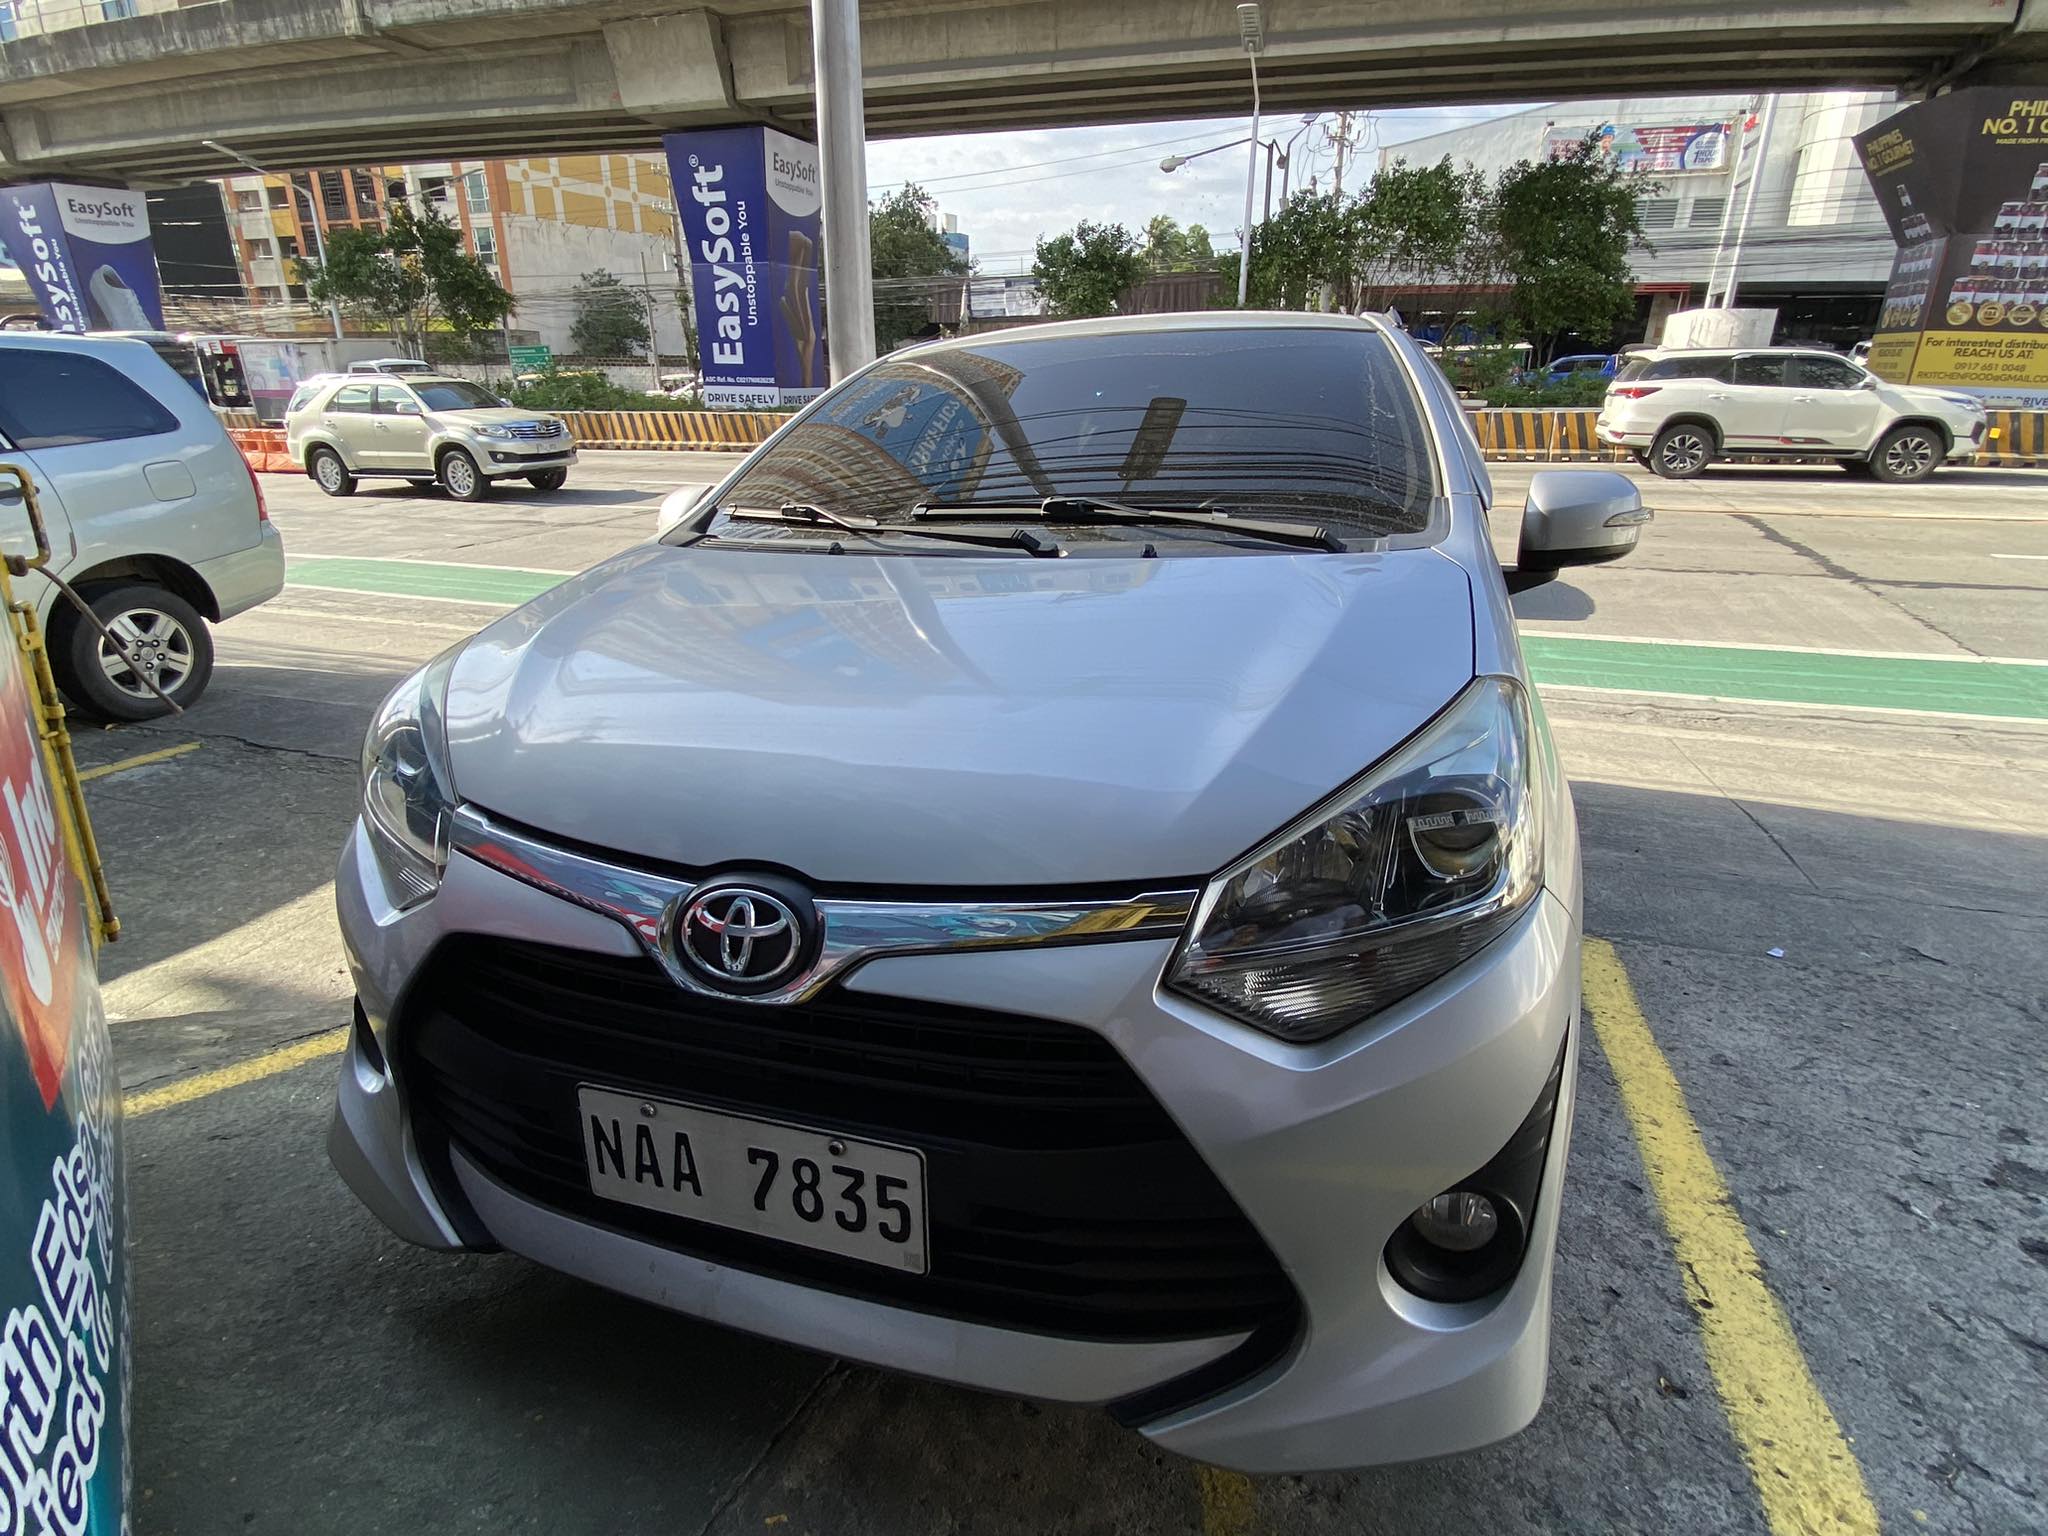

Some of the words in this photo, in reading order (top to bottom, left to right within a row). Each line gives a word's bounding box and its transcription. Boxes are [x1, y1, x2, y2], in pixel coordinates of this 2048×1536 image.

[1982, 118, 2018, 135] NO.
[2026, 118, 2036, 134] 1
[773, 151, 816, 184] EasySoft
[67, 198, 135, 218] EasySoft
[736, 201, 747, 229] You
[51, 238, 62, 260] You
[18, 204, 76, 332] sySoft
[692, 164, 746, 365] EasySoft
[741, 233, 758, 326] Unstoppable
[1925, 337, 1945, 347] For
[1946, 337, 2003, 348] interested
[1953, 347, 1996, 358] REACH
[1998, 349, 2014, 359] US
[2015, 349, 2034, 360] AT:
[1954, 361, 1979, 371] 0917
[708, 393, 736, 403] DRIVE
[738, 394, 775, 404] SAFELY
[783, 395, 802, 404] DRIVE
[2016, 396, 2048, 408] RIVE
[591, 1114, 703, 1197] NAA
[747, 1146, 912, 1244] 7835
[32, 1110, 97, 1338] Edsa
